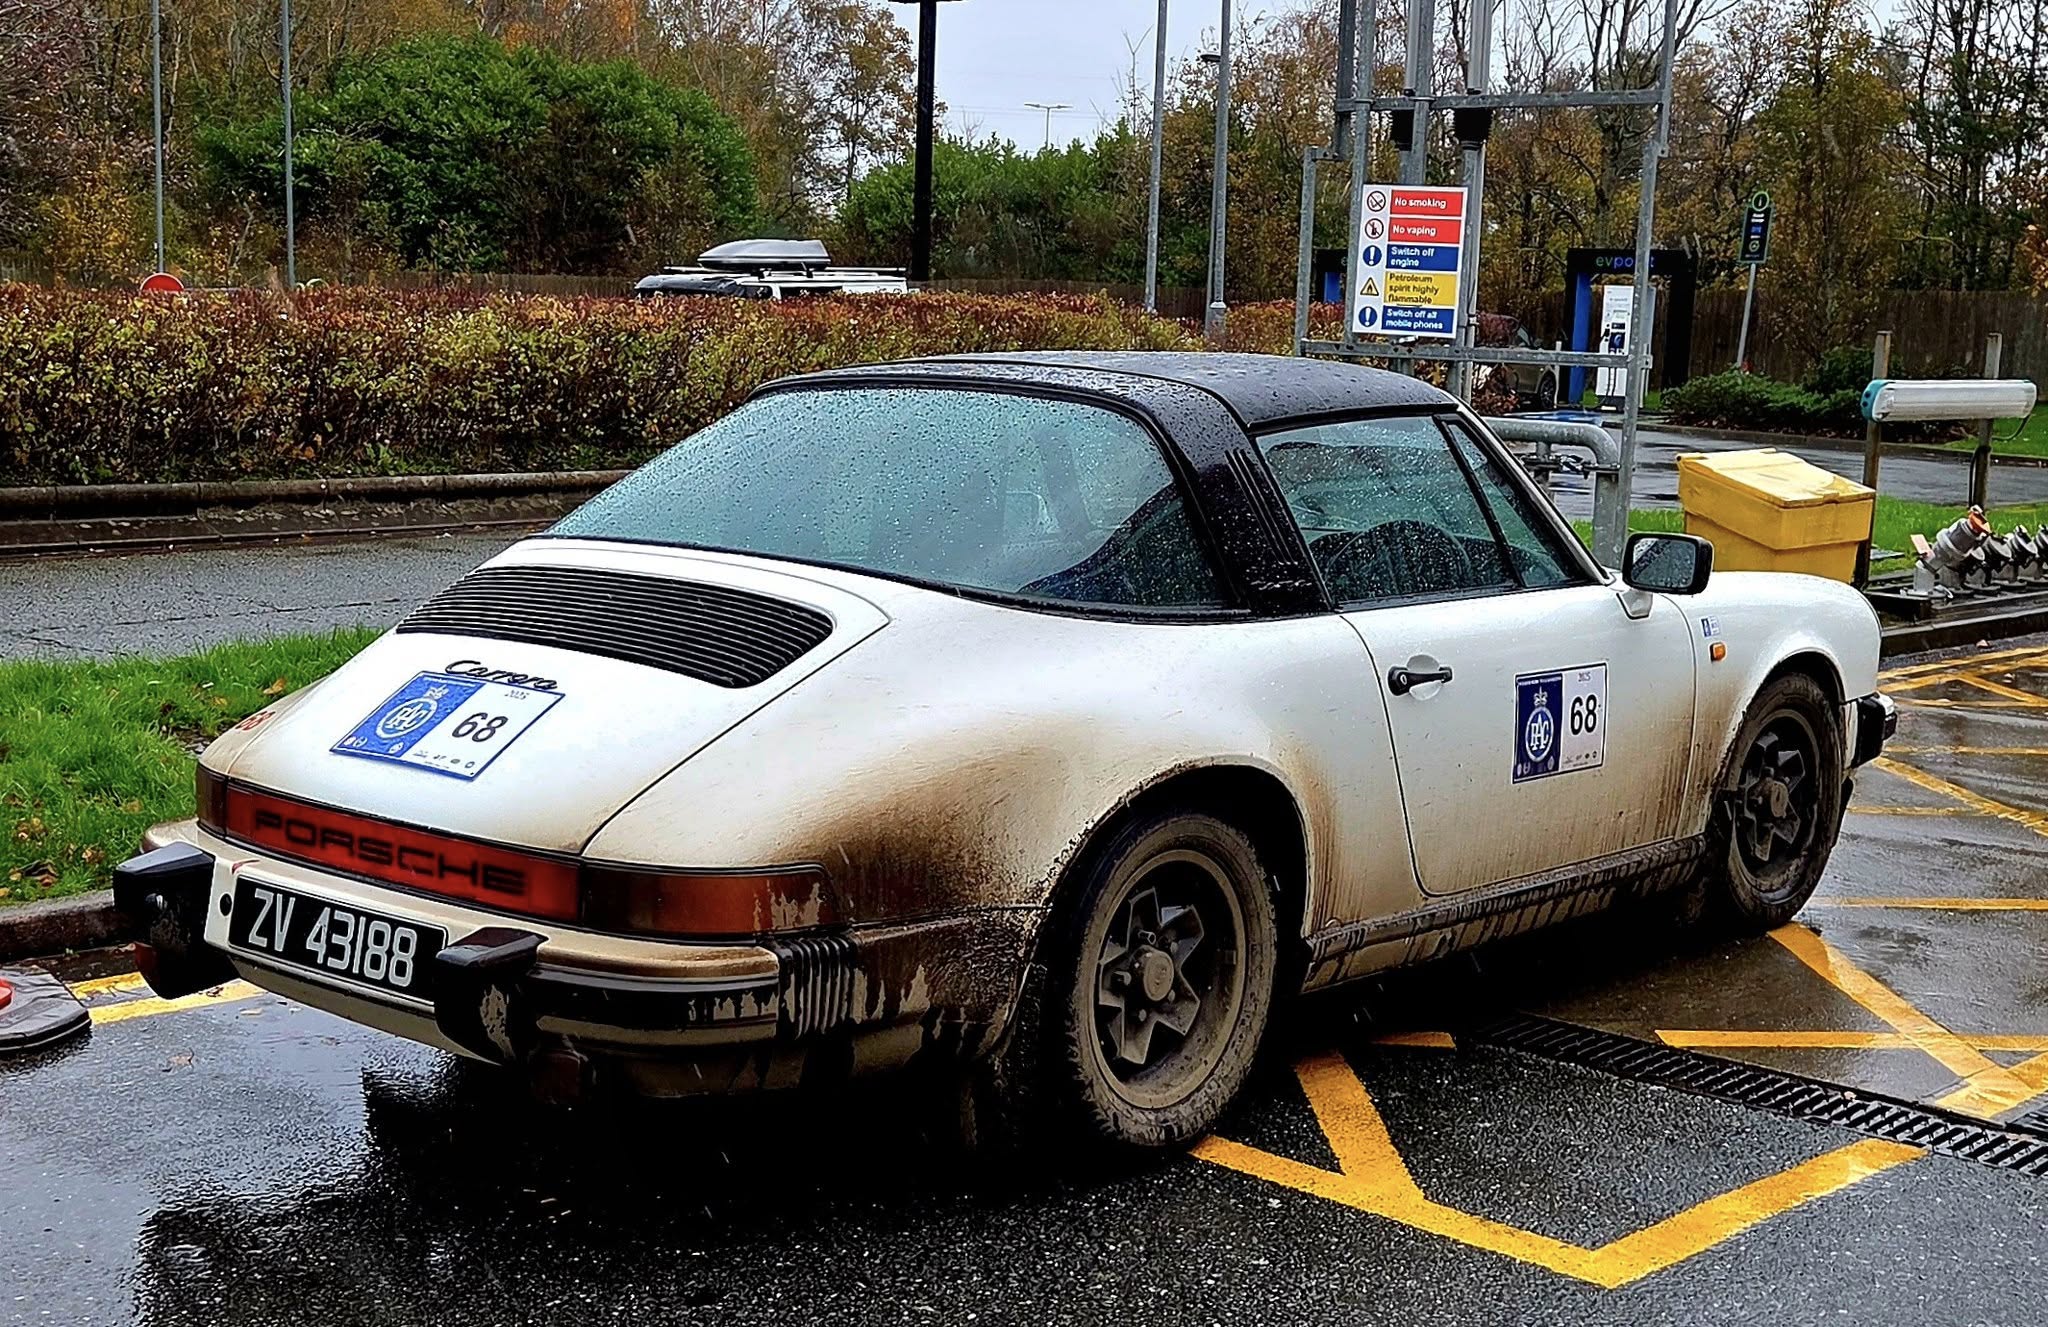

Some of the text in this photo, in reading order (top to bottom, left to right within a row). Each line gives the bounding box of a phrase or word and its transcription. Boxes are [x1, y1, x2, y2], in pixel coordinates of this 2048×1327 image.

[1394, 197, 1447, 210] No smoking
[1392, 224, 1437, 237] No vaping
[1391, 246, 1435, 257] Switch off
[1390, 257, 1420, 268] engine
[1596, 255, 1655, 269] evpot
[1389, 273, 1433, 283] Petroleum
[1389, 285, 1439, 296] spirit highly
[1388, 293, 1433, 304] flammable
[1387, 308, 1413, 318] Switch
[1426, 311, 1438, 319] all
[1385, 319, 1443, 330] mobile phones
[444, 659, 559, 690] Carrera
[1570, 695, 1598, 736] 68
[451, 712, 509, 743] 68
[254, 810, 528, 896] PORSCHE
[248, 887, 418, 989] ZV 43188
